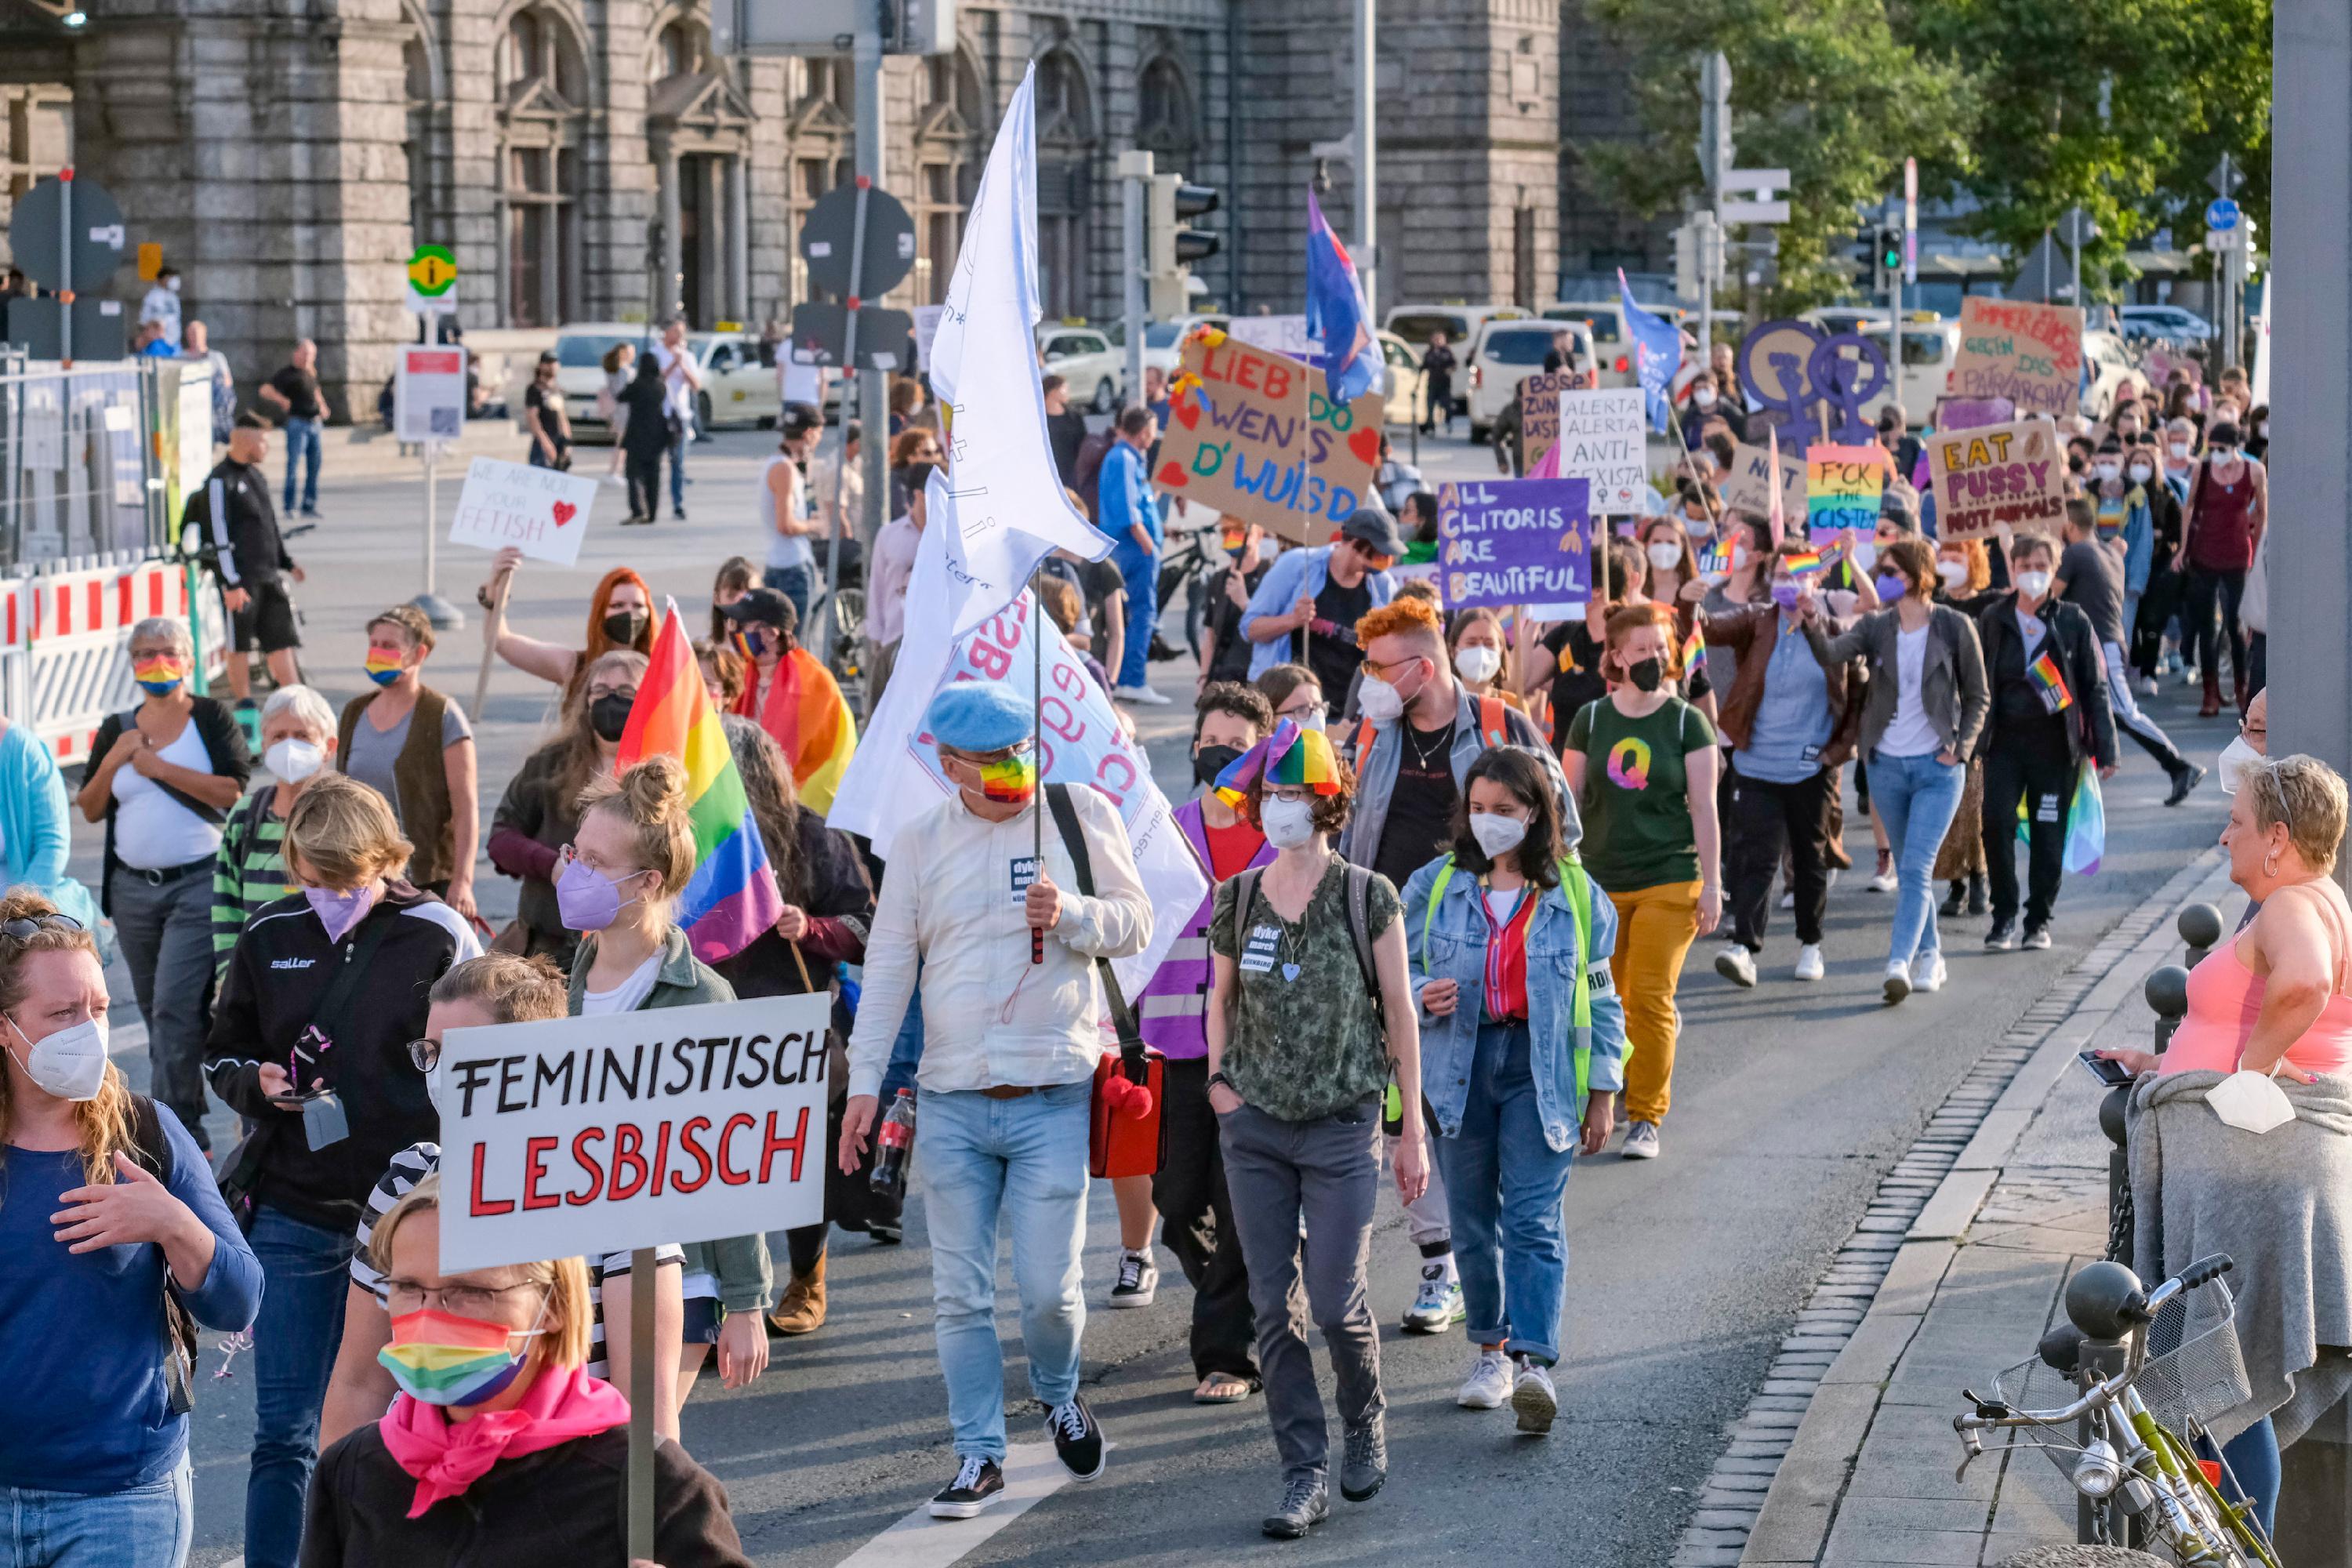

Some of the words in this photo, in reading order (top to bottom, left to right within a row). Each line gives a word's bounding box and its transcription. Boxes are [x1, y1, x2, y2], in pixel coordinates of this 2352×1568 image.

[1201, 347, 1307, 400] LIEB'
[1525, 397, 1560, 416] ZUN
[1566, 398, 1639, 417] ALERTA
[1567, 418, 1640, 437] ALERTA
[1573, 439, 1639, 463] ANTI-
[1944, 432, 2013, 471] EAT
[472, 463, 495, 481] WE
[505, 470, 533, 488] ARE
[539, 476, 572, 493] NOT
[1947, 459, 2051, 503] PUSSY
[484, 492, 528, 509] YOUR
[1439, 481, 1499, 509] ALL
[1831, 488, 1863, 503] THE
[459, 506, 546, 541] FETISH
[1441, 507, 1564, 538] CLITORIS
[1946, 509, 1991, 535] NOT
[1992, 495, 2063, 523] ANIMALS
[1445, 539, 1497, 566] ARE
[1450, 565, 1588, 603] BEAUTIFUL
[1606, 737, 1651, 791] Q
[1014, 861, 1035, 873] dyk
[1249, 941, 1275, 951] march
[270, 957, 316, 969] saller
[452, 1029, 829, 1117] FEMINISTISCH
[470, 1106, 811, 1218] LESBISCH
